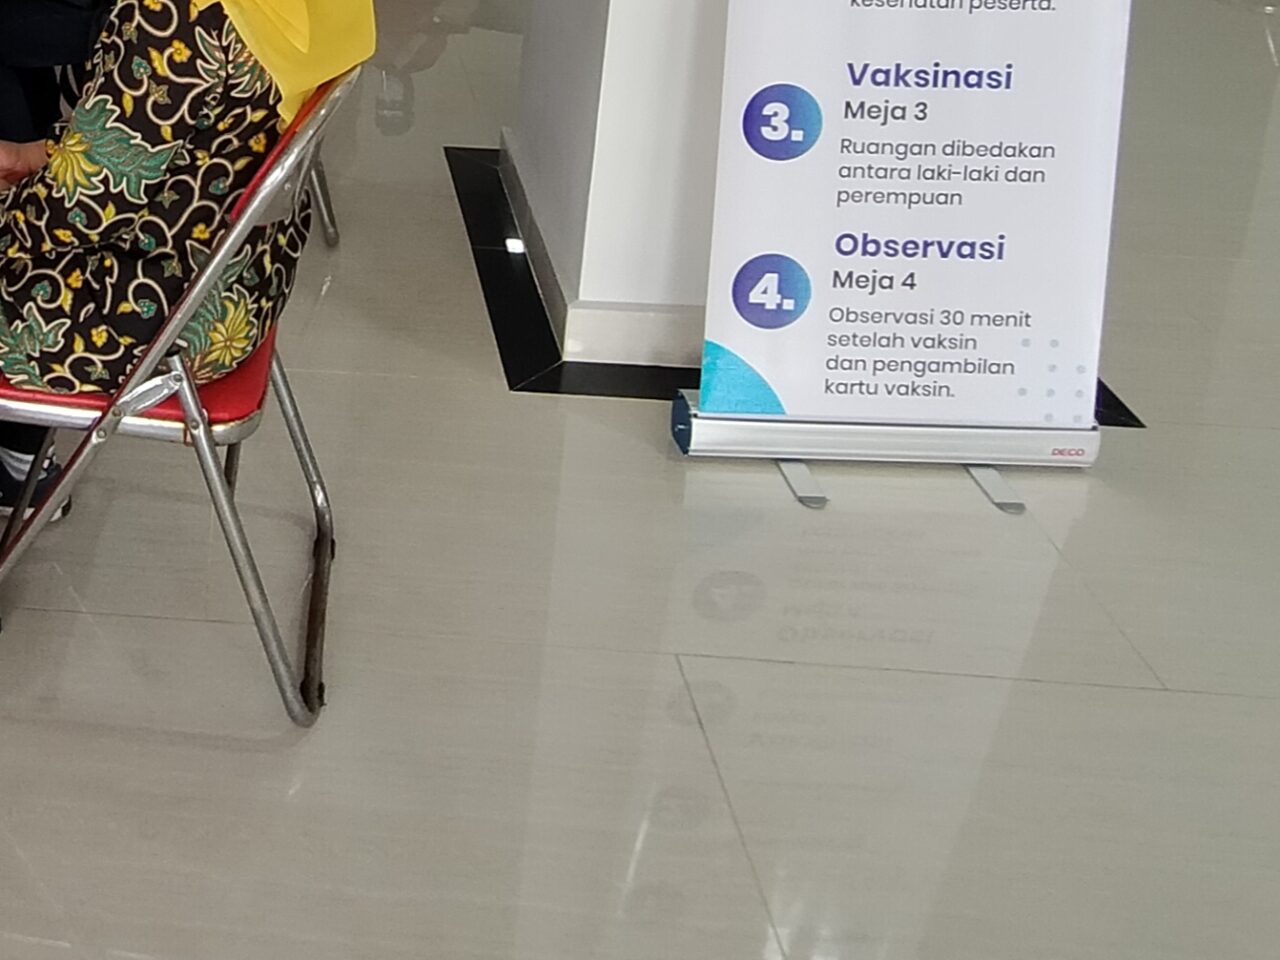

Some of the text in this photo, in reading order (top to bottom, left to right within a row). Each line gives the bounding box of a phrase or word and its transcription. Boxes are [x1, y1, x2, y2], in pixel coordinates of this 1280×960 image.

[846, 61, 1013, 90] Vaksinasi
[760, 102, 804, 142] 3.
[843, 99, 928, 127] Meja 3
[839, 138, 1056, 161] Ruangan dibedakan
[838, 163, 1046, 183] antara laki-laki dan
[836, 190, 963, 210] perempuan
[835, 232, 1006, 261] Observasi
[748, 272, 795, 311] 4.
[832, 268, 917, 296] Meja 4
[828, 306, 1032, 328] Observasi 30 menit
[827, 331, 978, 351] setelah vaksin
[825, 354, 1015, 378] dan pengambilan
[824, 377, 955, 398] kartu vaksin.
